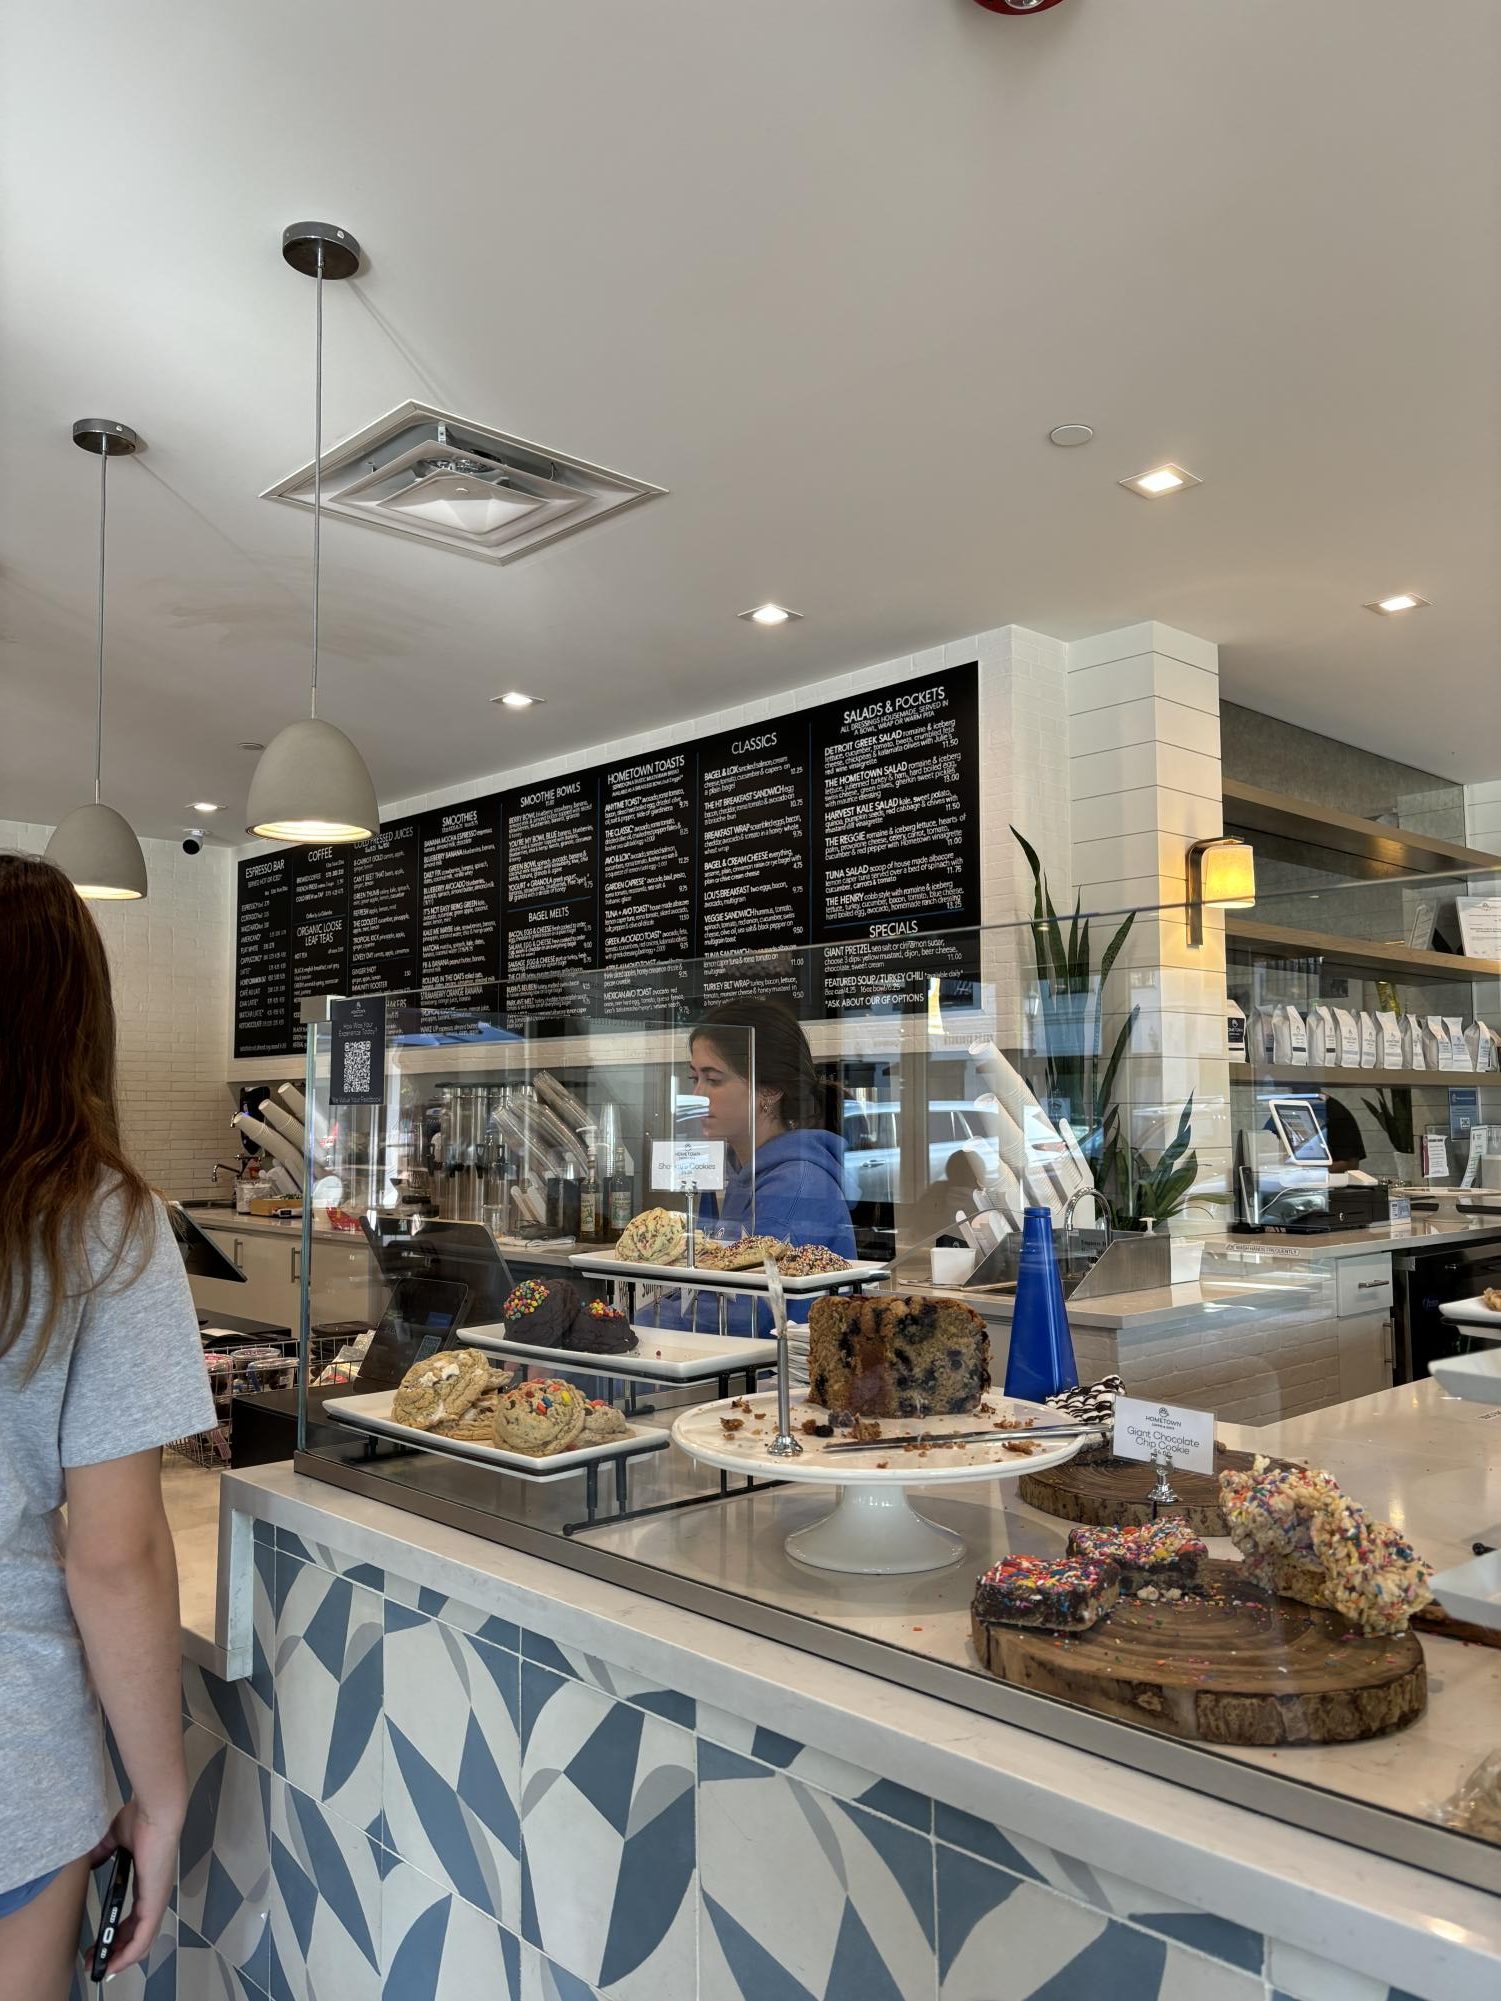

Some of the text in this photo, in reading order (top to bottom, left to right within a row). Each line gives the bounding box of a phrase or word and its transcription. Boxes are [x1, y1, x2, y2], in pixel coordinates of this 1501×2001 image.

[844, 686, 944, 723] SALADS & POCKETS
[851, 717, 879, 730] DRESSINGS
[919, 701, 940, 713] SERVED
[878, 720, 892, 729] WRAP
[904, 713, 921, 723] WARM
[922, 710, 934, 718] PITA
[732, 732, 776, 755] CLASSICS
[824, 741, 852, 755] DETROIT
[855, 735, 876, 748] GREEK
[879, 729, 901, 742] SALAD
[903, 726, 925, 736] romaine
[933, 717, 955, 730] iceberg
[942, 739, 958, 748] 11.50
[608, 763, 652, 784] HOMETOWN
[654, 754, 684, 772] TOASTS
[704, 765, 738, 780] BAGEL & LOX
[825, 750, 960, 787] THE HOMETOWN SALAD romaine & iceberg
[944, 773, 959, 782] 13.00
[520, 789, 555, 807] SMOOTHIE
[557, 782, 580, 797] BOWLS
[704, 801, 714, 810] THE
[715, 799, 722, 808] HT
[723, 792, 752, 806] BREAKFAST
[753, 785, 783, 799] SANDWICH
[825, 807, 854, 820] HARVEST
[856, 803, 873, 814] KALE
[876, 798, 898, 810] SALAD
[913, 794, 929, 802] sweet
[946, 802, 959, 810] 11.50
[442, 809, 476, 827] SMOOTHIES
[395, 826, 413, 840] JUICES
[704, 823, 749, 839] BREAKFAST WRAP
[792, 829, 802, 837] 9.75
[825, 836, 838, 846] THE
[840, 831, 865, 844] REGGIE
[867, 829, 887, 838] romaine
[895, 823, 915, 835] iceberg
[939, 815, 956, 824] hearts
[960, 812, 966, 820] of
[948, 837, 961, 845] 11.00
[308, 846, 332, 862] COFFEE
[704, 860, 721, 870] BAGEL
[727, 855, 746, 866] CREAM
[747, 851, 767, 862] CHEESE
[245, 859, 284, 878] ESPRESSO BAR
[825, 869, 844, 879] TUNA
[846, 865, 867, 876] SALAD
[870, 864, 885, 873] scoop
[929, 852, 953, 861] albacore
[947, 865, 961, 873] 11.75
[720, 885, 749, 897] BREAKFAST
[826, 893, 863, 906] THE HENRY
[528, 906, 568, 921] BAGEL MELTS
[704, 908, 754, 922] VEGGIE SANDWICH
[296, 920, 342, 937] ORGANIC LOOSE
[870, 920, 917, 937] SPECIALS
[306, 932, 333, 946] LEAF TEAS
[824, 946, 843, 957] GIANT
[845, 943, 870, 954] PRETZEL
[900, 939, 926, 948] cinnamon
[861, 953, 878, 962] yellow
[704, 979, 749, 990] TURKEY BLT WRAP
[824, 976, 856, 987] FEATURED
[906, 971, 922, 980] CHILI
[637, 988, 651, 996] TOAST
[842, 998, 863, 1006] ABOUT
[866, 996, 880, 1004] OUR
[892, 993, 923, 1002] OPTIONS
[1145, 1415, 1181, 1427] HOMETOWN
[1127, 1426, 1151, 1438] Giant
[1153, 1431, 1200, 1447] Chocolate
[1135, 1436, 1189, 1454] Chip Cookie
